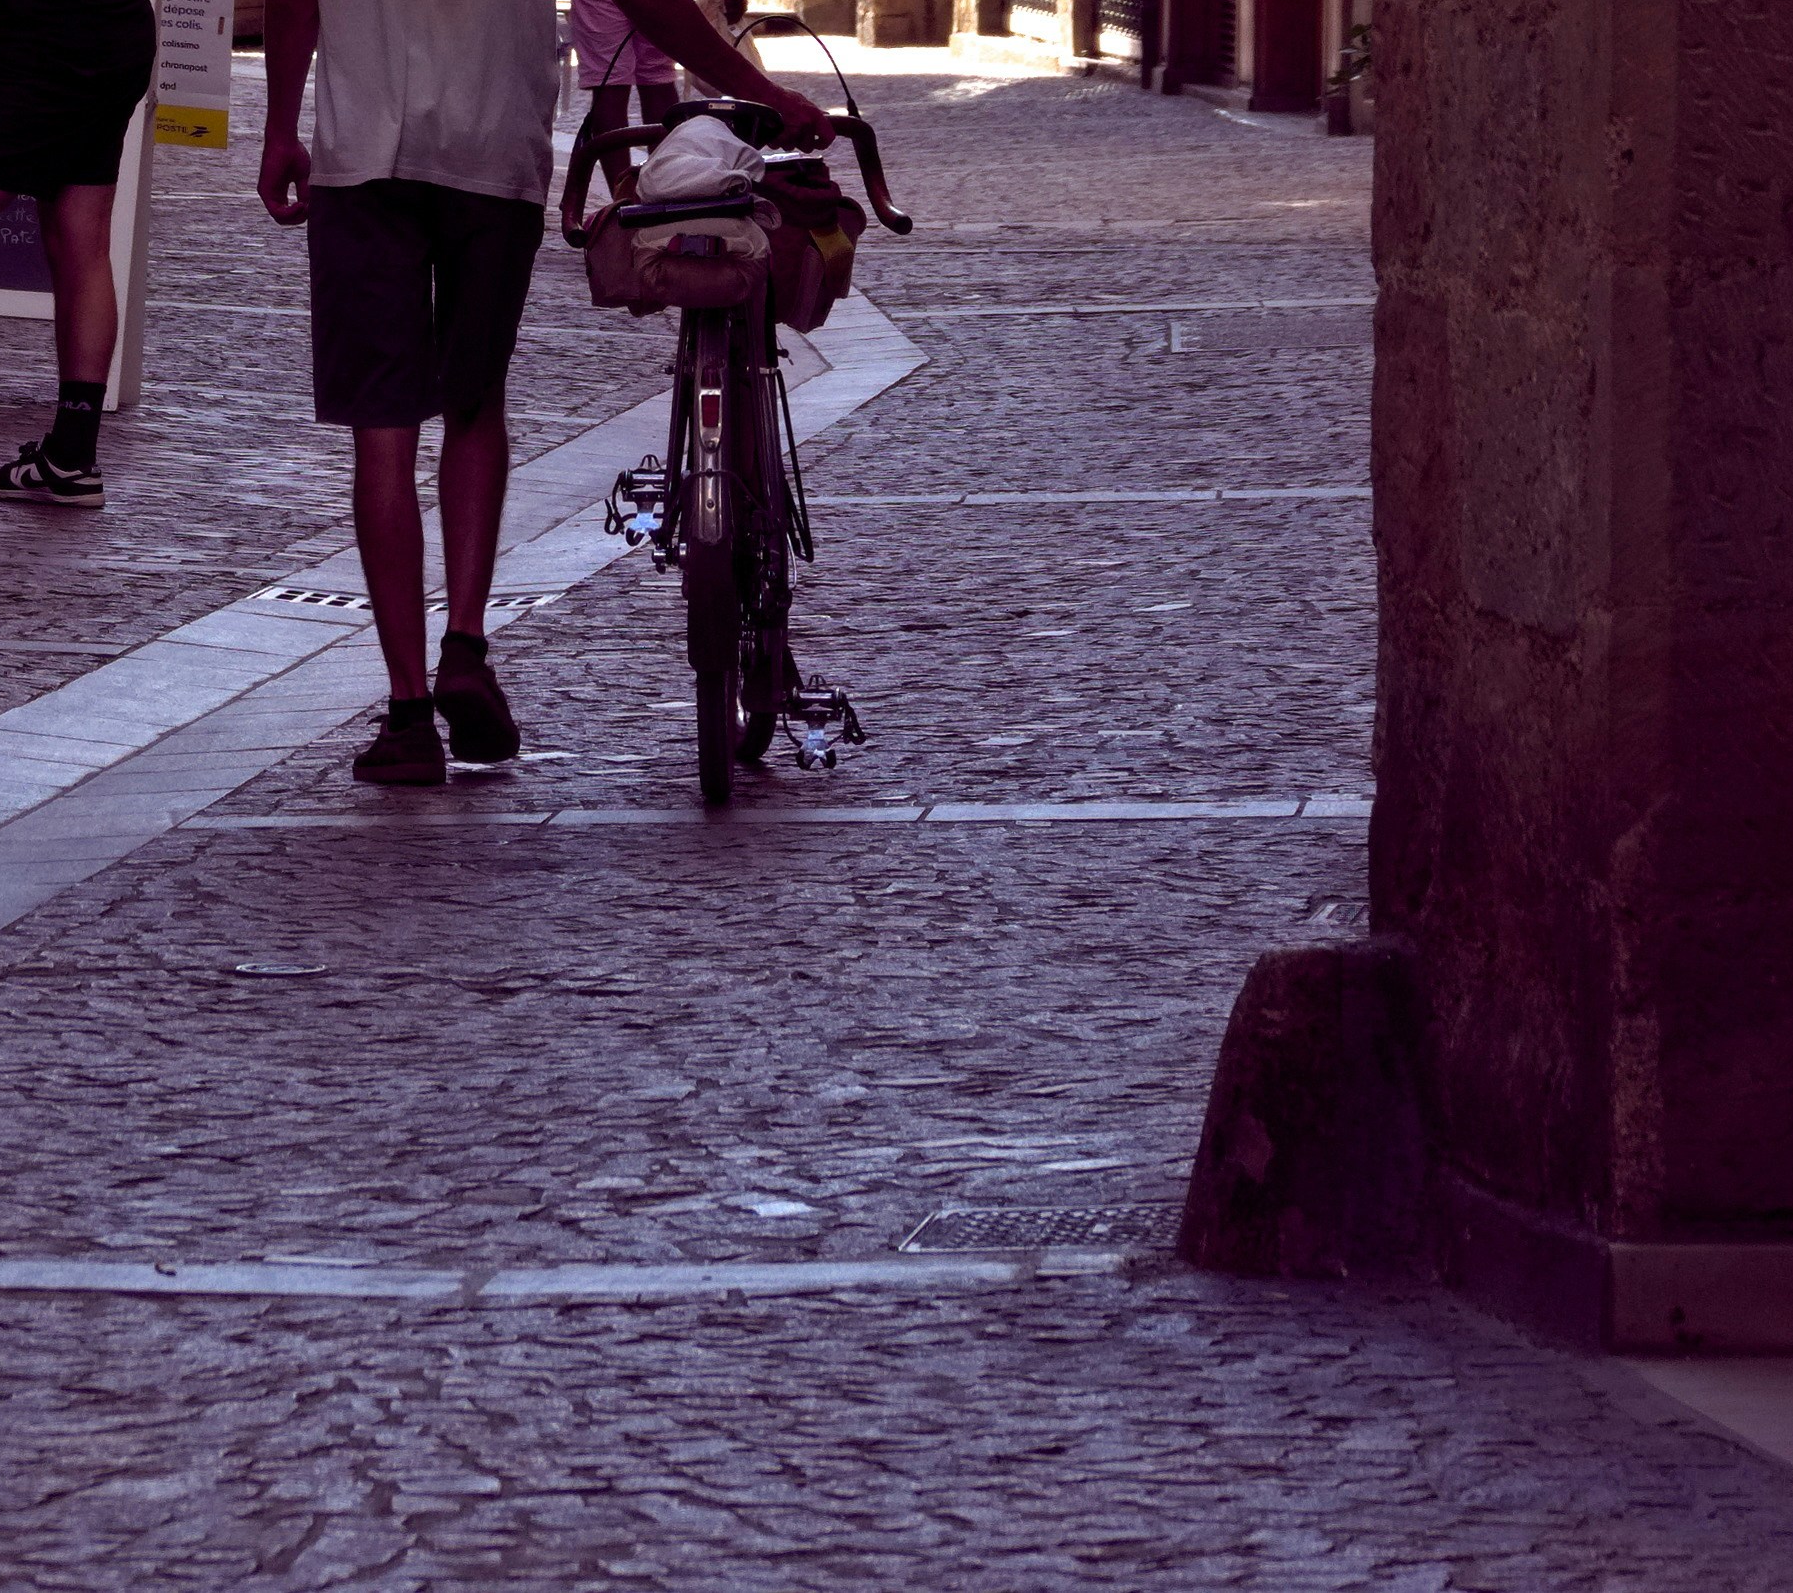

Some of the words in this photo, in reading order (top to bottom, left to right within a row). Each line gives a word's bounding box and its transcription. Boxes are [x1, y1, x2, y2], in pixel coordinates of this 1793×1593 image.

[163, 3, 206, 18] dépose
[161, 18, 173, 28] es
[161, 39, 201, 51] colissimo
[160, 59, 209, 74] chronopost
[159, 79, 177, 92] dpd
